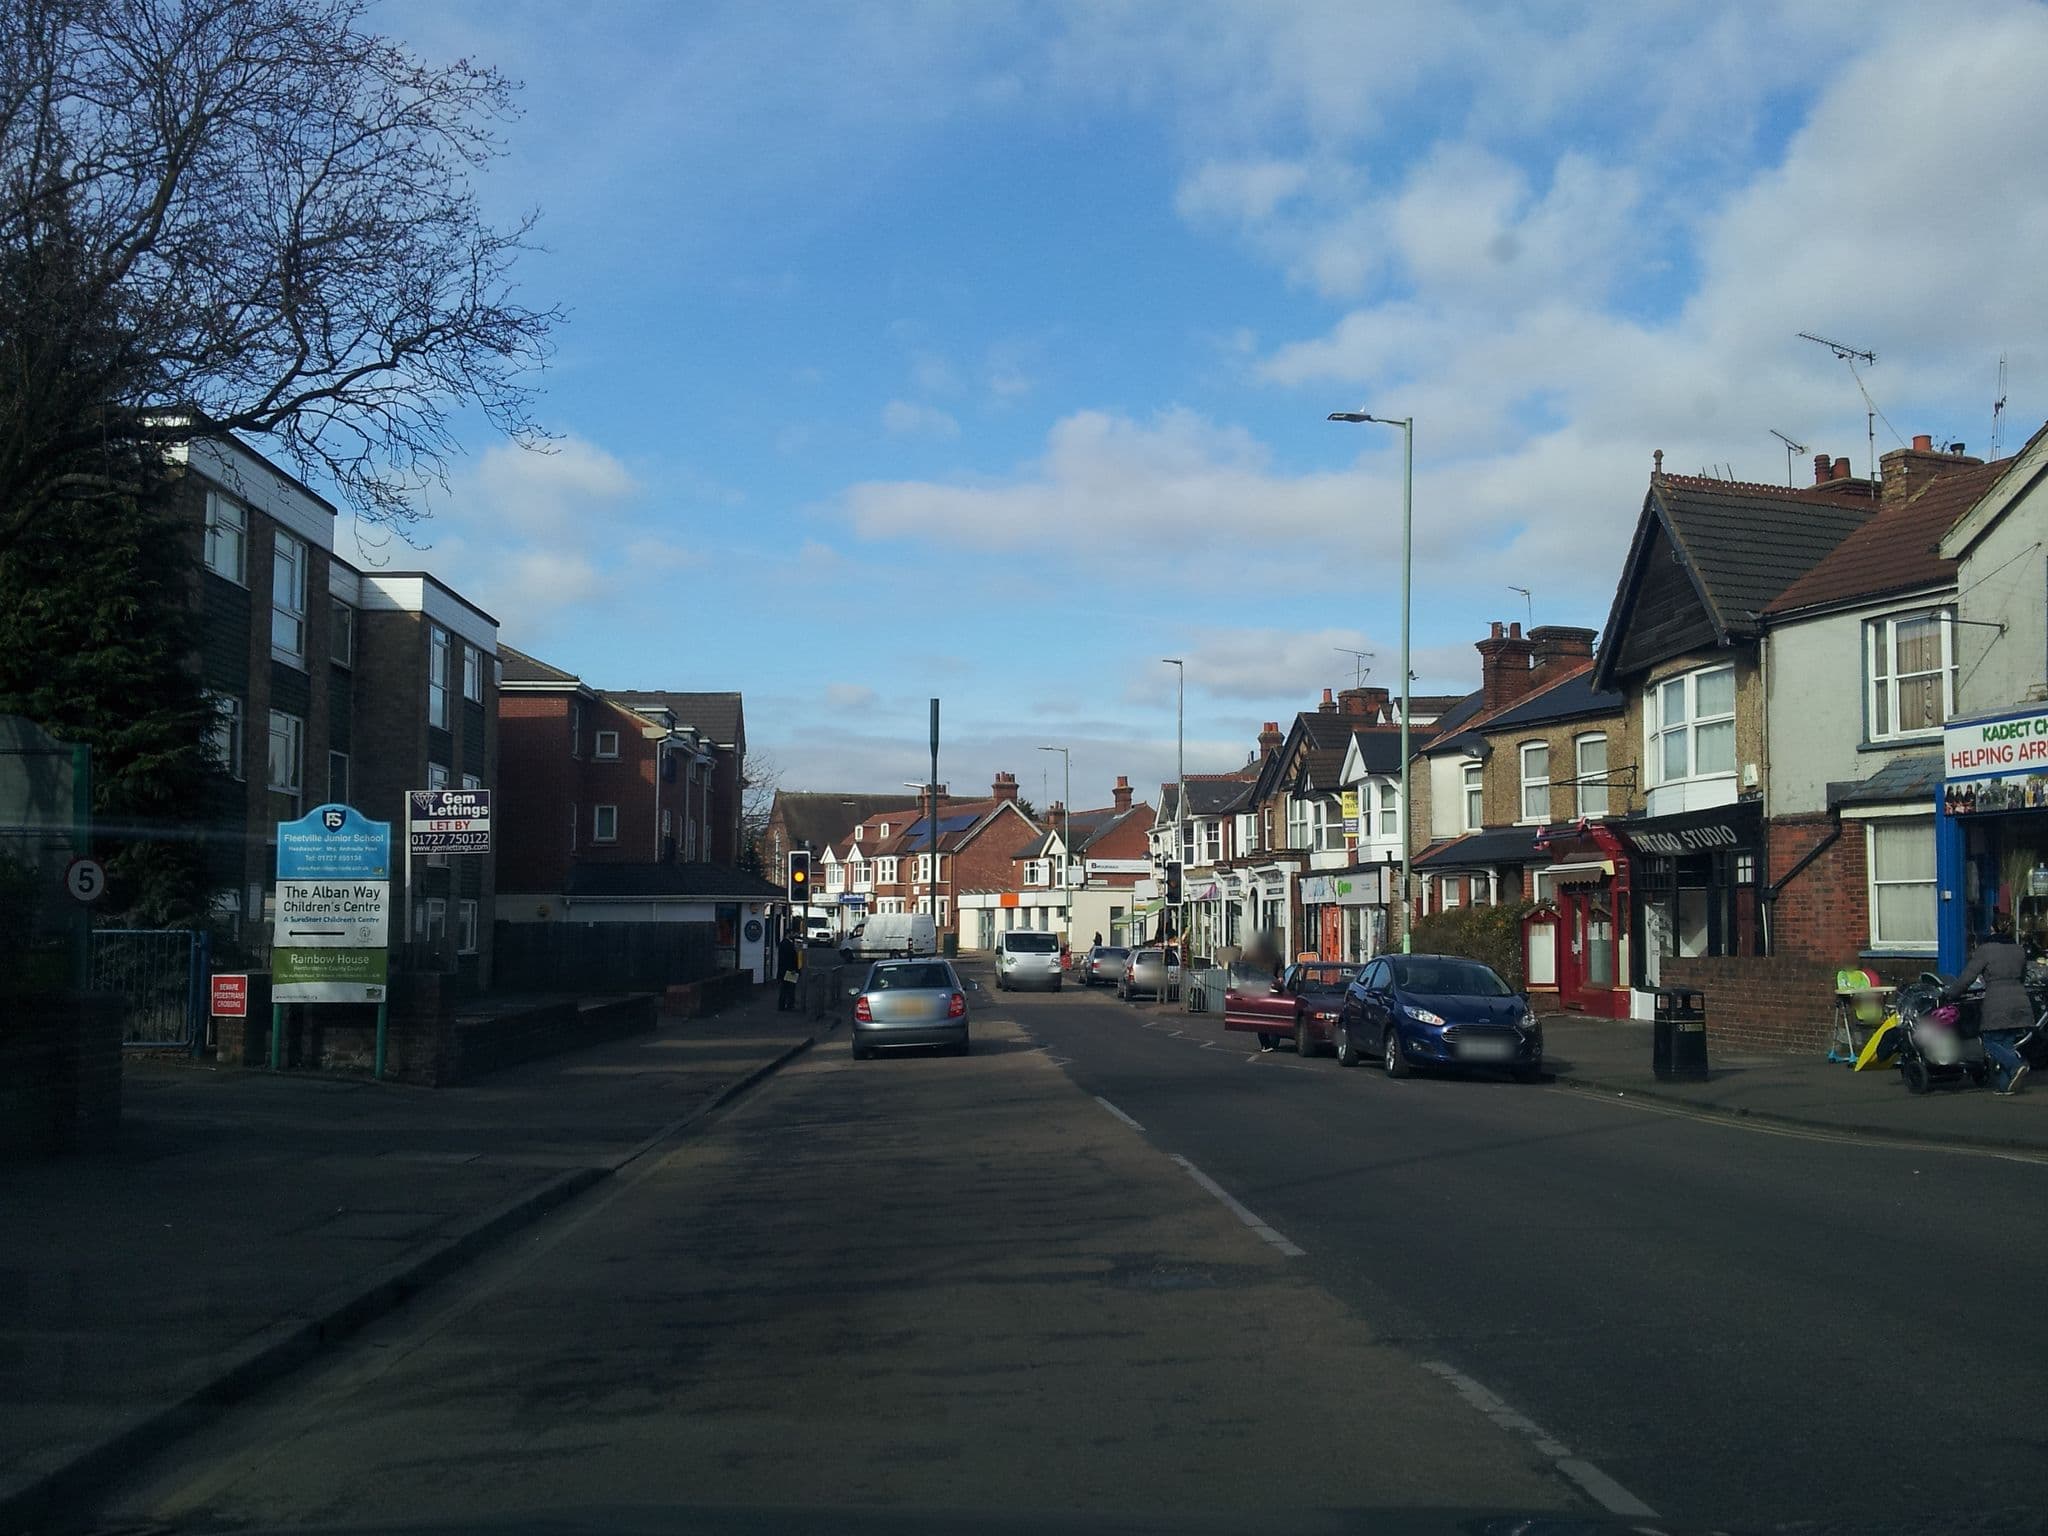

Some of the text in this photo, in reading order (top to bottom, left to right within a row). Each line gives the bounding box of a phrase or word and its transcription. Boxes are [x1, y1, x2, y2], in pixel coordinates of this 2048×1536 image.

[1982, 721, 2031, 742] KADECT
[1951, 745, 2014, 769] HELPING
[442, 792, 476, 804] Gem
[428, 804, 489, 818] Lettings
[430, 821, 471, 831] LET BY
[284, 834, 384, 842] Fleetville Junior School
[411, 833, 489, 845] 01727 750122
[1630, 825, 1738, 853] TATTOO STUDIO
[412, 844, 489, 853] www.gemlettings.com
[78, 868, 94, 893] 5
[284, 886, 381, 900] The Alban Way
[283, 901, 381, 912] Children's Centre
[290, 954, 369, 964] Rainbow House
